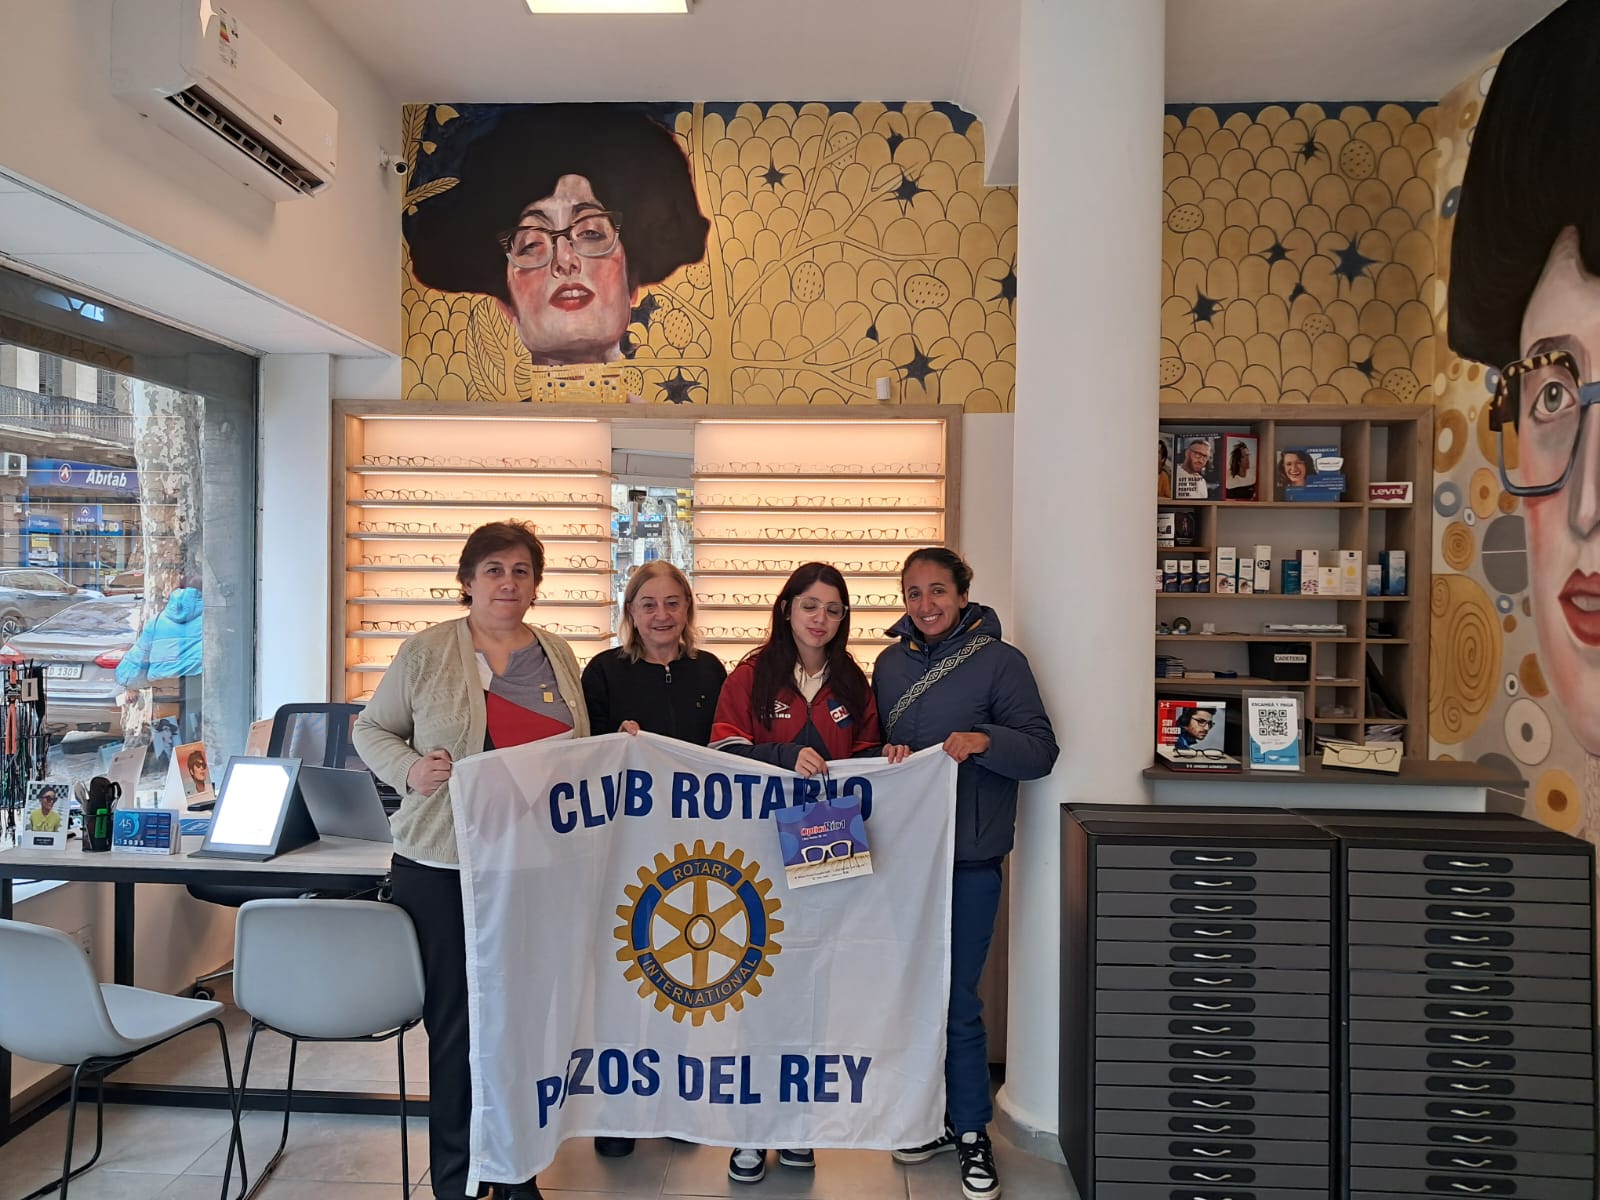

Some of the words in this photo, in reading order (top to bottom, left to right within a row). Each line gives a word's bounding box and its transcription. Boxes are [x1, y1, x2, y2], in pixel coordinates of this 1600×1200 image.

[86, 469, 127, 487] Abitab
[550, 769, 653, 834] CLUB
[672, 861, 733, 883] ROTARY
[642, 959, 757, 1005] INTERNATIONAL
[536, 1048, 660, 1129] PZOS
[678, 1054, 762, 1104] DEL
[779, 1054, 873, 1103] REY
